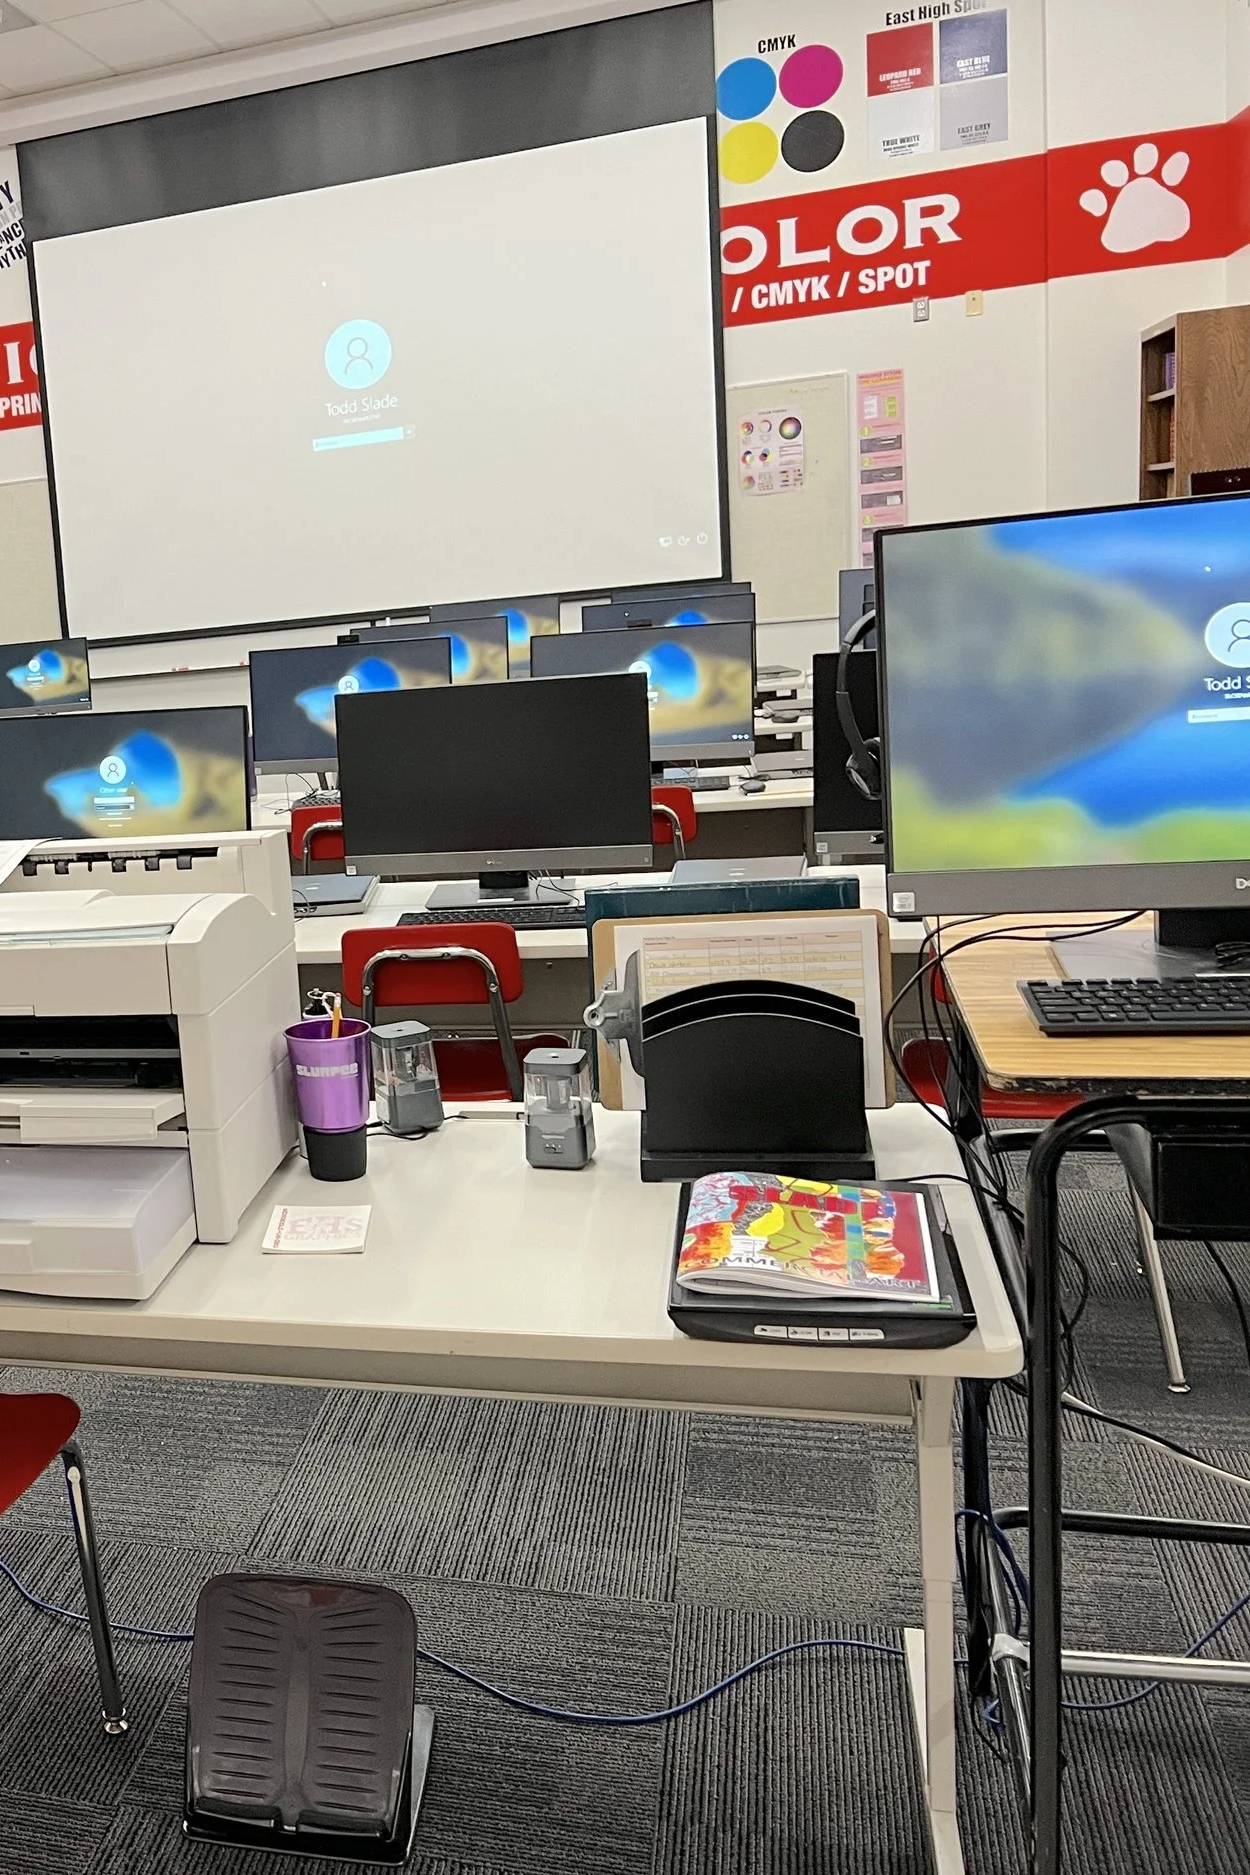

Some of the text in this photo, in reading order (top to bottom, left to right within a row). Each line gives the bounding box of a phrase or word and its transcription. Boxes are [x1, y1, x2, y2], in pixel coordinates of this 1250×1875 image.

[886, 9, 915, 26] East
[918, 2, 950, 20] High
[757, 34, 796, 55] CMYK
[751, 274, 830, 309] CMYK
[858, 260, 931, 294] SPOT
[325, 393, 399, 416] Todd Slade
[1203, 675, 1242, 691] Todd
